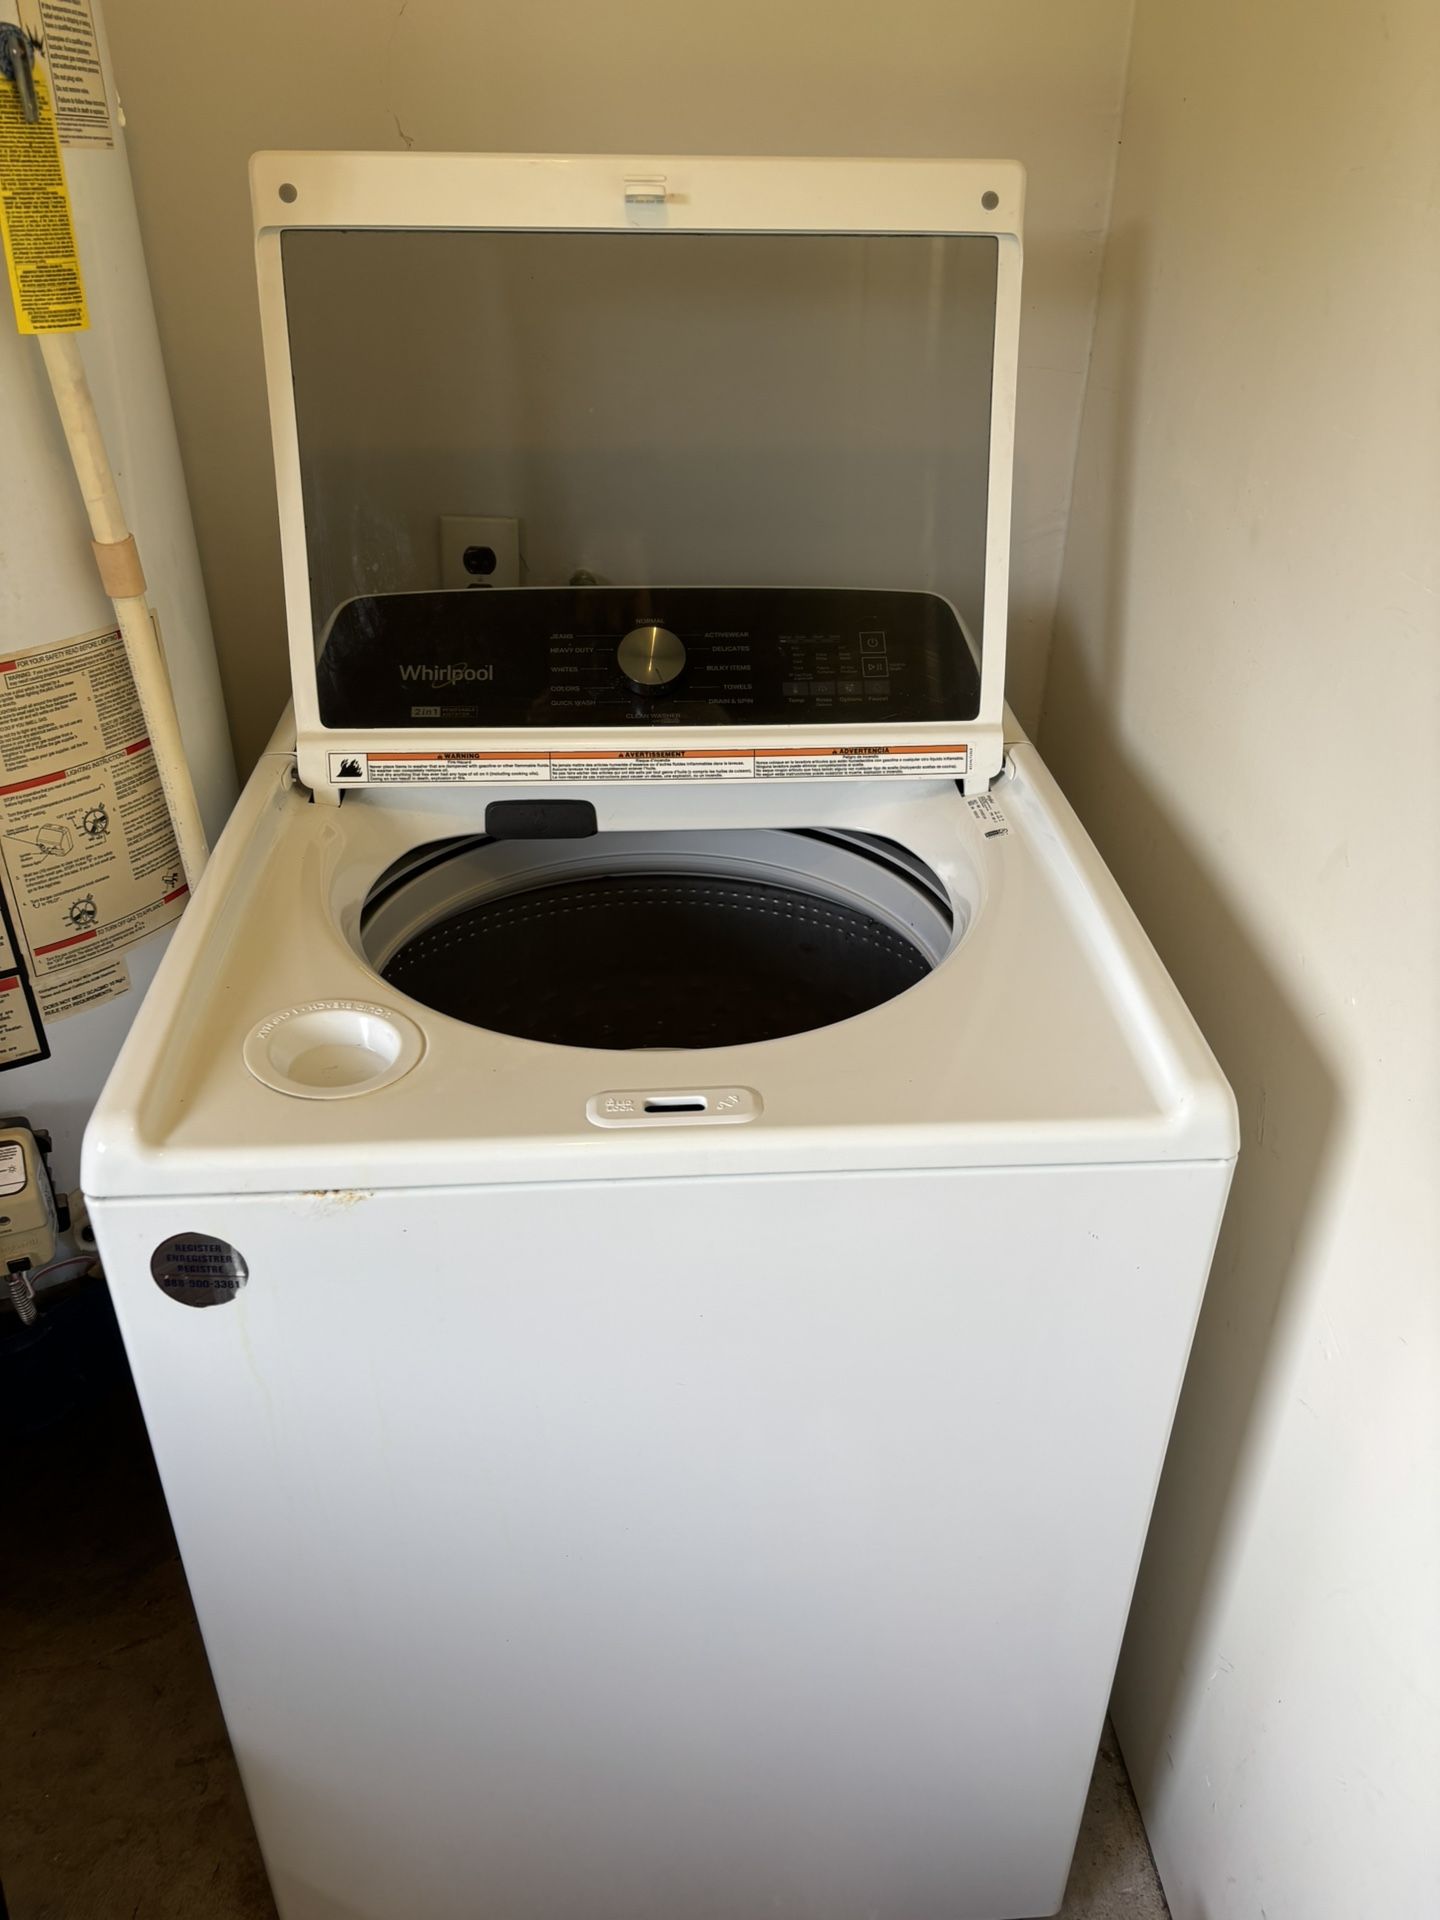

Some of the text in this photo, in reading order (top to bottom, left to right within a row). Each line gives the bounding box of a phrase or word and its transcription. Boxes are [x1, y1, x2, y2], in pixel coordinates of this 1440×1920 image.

[17, 660, 29, 668] FOR
[30, 656, 45, 664] YOUR
[45, 651, 64, 661] SAFETY
[65, 646, 79, 655] READ
[79, 641, 98, 652] BEFORE
[399, 662, 494, 686] Whirlpool
[66, 765, 91, 777] LIGHTING
[59, 998, 71, 1006] NOT
[175, 1244, 222, 1252] REGISTER
[166, 1254, 233, 1263] ENREGISTRER
[177, 1265, 224, 1273] REGISTRE
